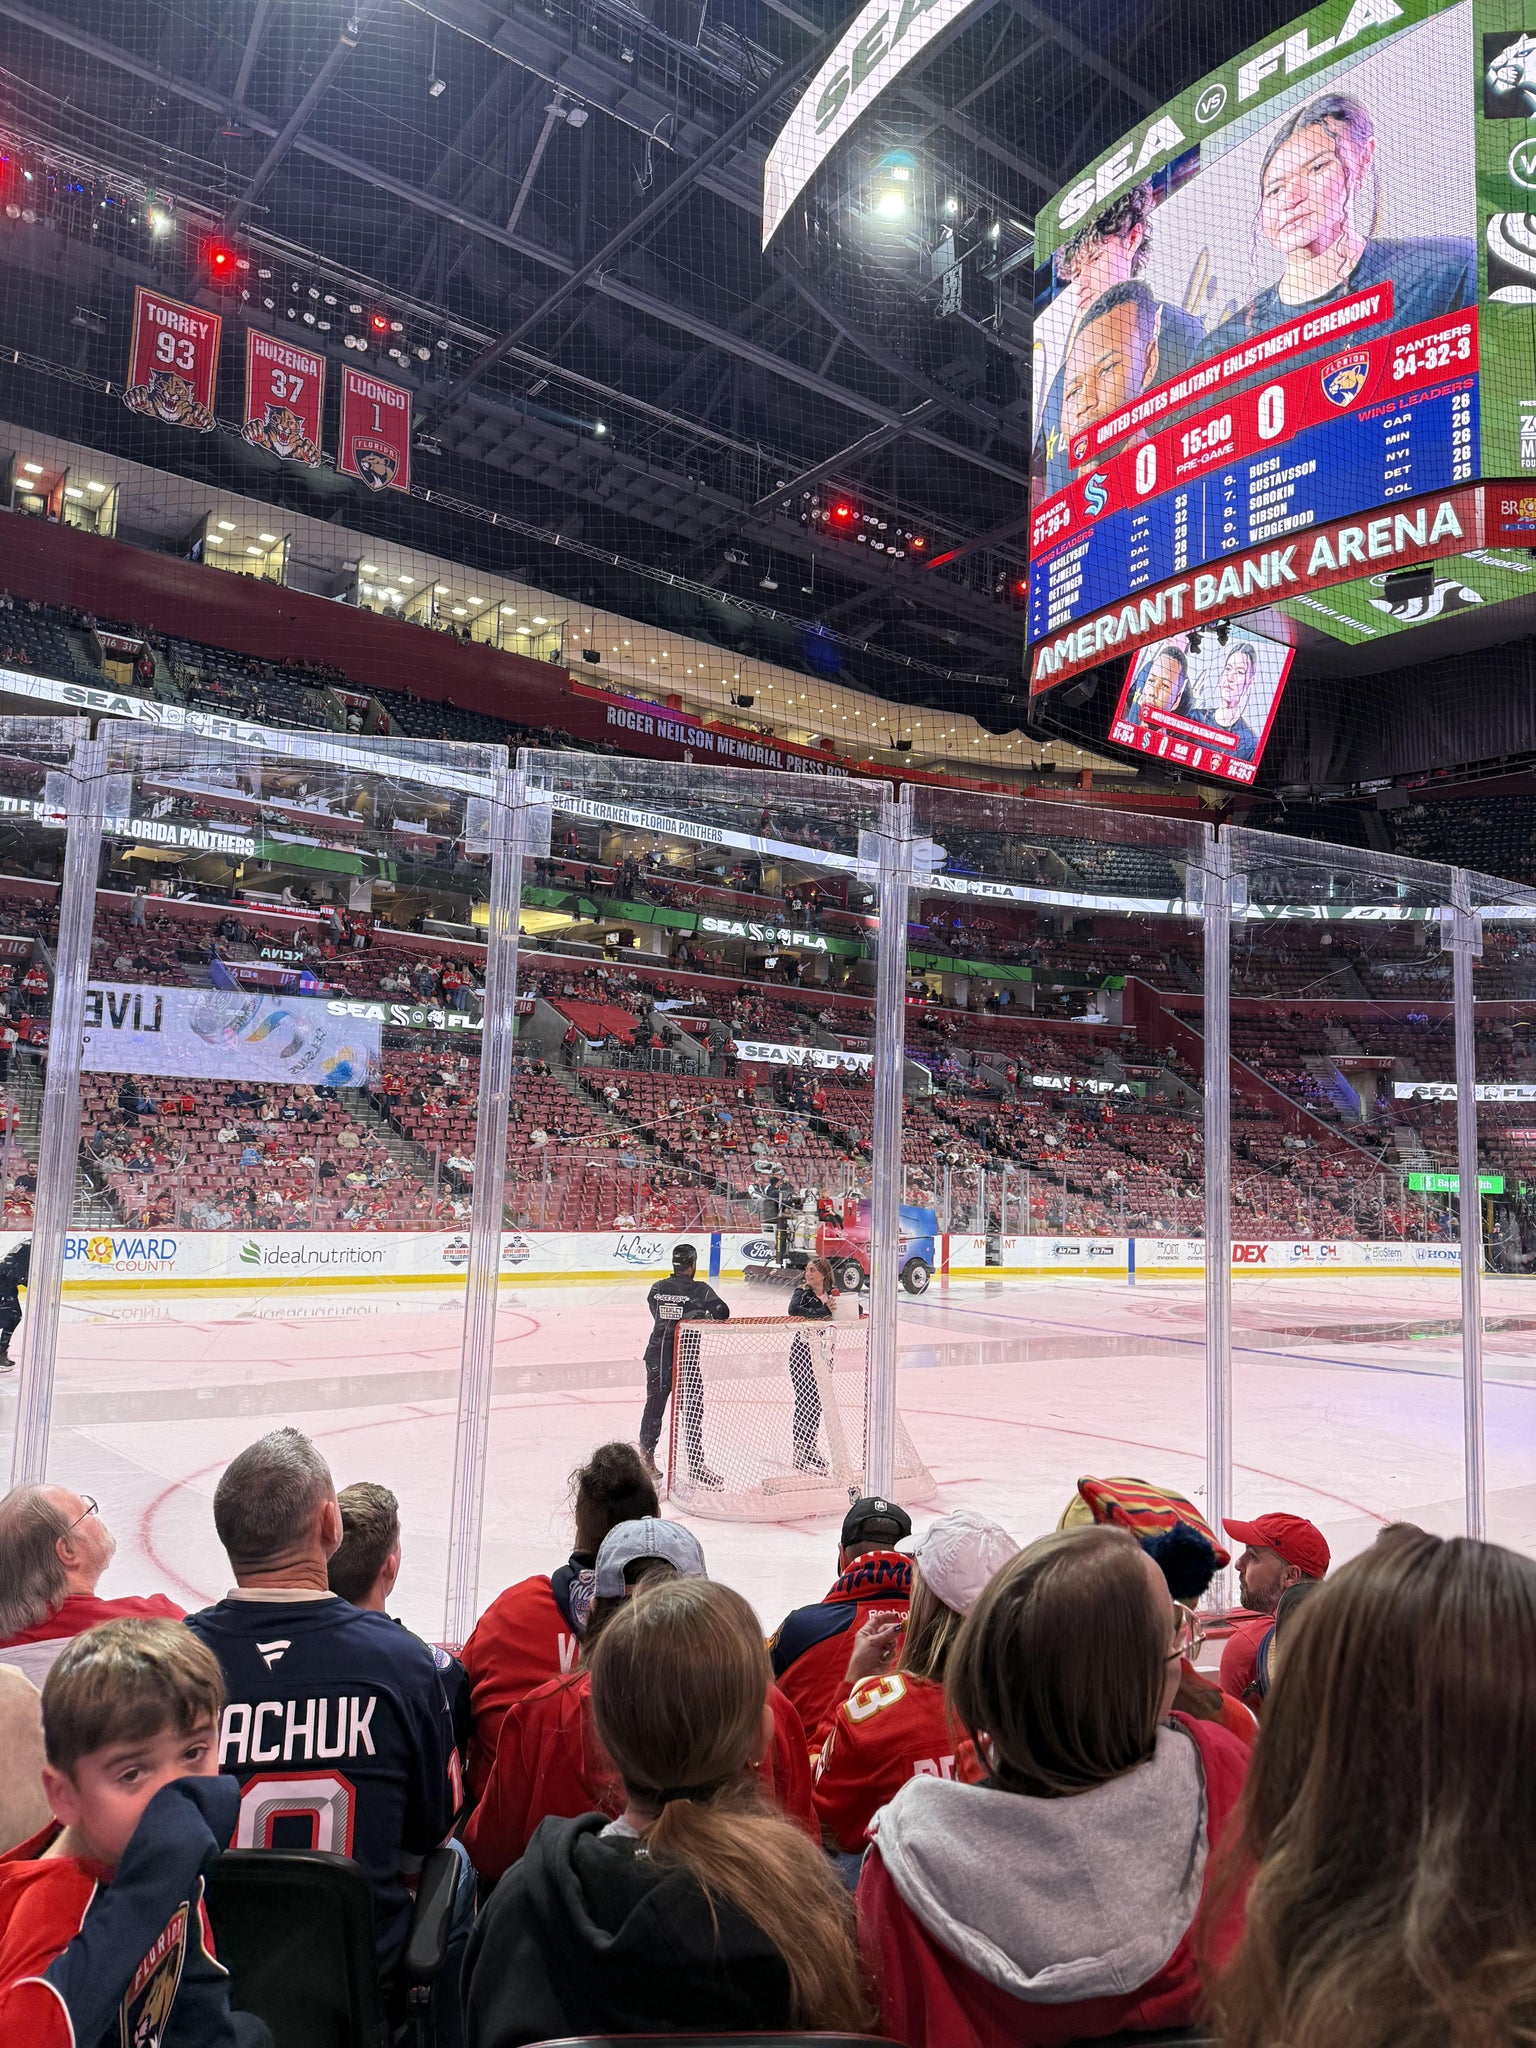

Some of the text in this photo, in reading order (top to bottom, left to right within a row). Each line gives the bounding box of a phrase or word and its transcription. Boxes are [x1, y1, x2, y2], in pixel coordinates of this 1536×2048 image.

[1059, 115, 1186, 230] SEA
[1238, 0, 1403, 102] FLA
[147, 302, 209, 340] TORREY
[156, 331, 195, 370] 93
[1396, 324, 1471, 357] PANTHERS
[255, 339, 318, 377] HUIZENGA
[1097, 294, 1381, 445] UNITED STATES MILITARY ENLISTMENT CEREMONY
[1393, 337, 1470, 380] 34-32-3
[270, 368, 304, 403] 37
[350, 375, 406, 410] LUONGO
[1357, 379, 1474, 422] WINS LEADERS
[371, 403, 383, 433] 1
[1258, 385, 1284, 440] 0
[357, 440, 395, 458] FLORIDA
[1181, 414, 1232, 458] 15:00
[1223, 393, 1470, 487] 6. BUSSI CAR 26
[1135, 444, 1156, 495] 0
[1176, 442, 1234, 475] PRE-GAME
[1223, 410, 1471, 502] 7. GUSTAVSSON MIN 26
[1223, 428, 1471, 517] 8. SOROKIN NYI 26
[1223, 445, 1471, 533] 9. GIBSON DET 26
[1035, 500, 1067, 526] KRAKEN
[1132, 515, 1149, 527] TBL
[1221, 463, 1471, 549] 10. WEDGEWOOD COL 25
[1130, 529, 1150, 542] UTA
[1174, 509, 1188, 525] 32
[1130, 545, 1149, 557] DAL
[1174, 524, 1188, 540] 29
[1036, 528, 1094, 568] WINS LEADERS
[1130, 558, 1149, 572] BOS
[1174, 539, 1188, 555] 28
[1130, 573, 1149, 587] ANA
[1174, 554, 1187, 571] 28
[1035, 500, 1465, 681] AMERANT BANK ARENA
[100, 637, 139, 653] 316 317
[62, 686, 268, 746] SEA FLA
[353, 698, 368, 708] 318
[607, 705, 654, 736] ROGER
[657, 718, 714, 751] NEILSON
[717, 734, 783, 770] MEMORIAL
[786, 755, 823, 776] PRESS
[1158, 736, 1168, 756] 0
[1192, 748, 1203, 767] 0
[552, 794, 591, 815] SEATTLE
[593, 803, 630, 822] KRAKEN
[641, 813, 677, 833] FLORIDA
[679, 822, 723, 842] PANTHERS
[115, 817, 176, 843] FLORIDA
[179, 828, 255, 856] PANTHERS
[912, 872, 941, 888] SEA
[982, 884, 1014, 897] FLA
[8, 942, 27, 954] 116
[702, 917, 828, 949] SEA FLA
[326, 1001, 386, 1021] SEA
[520, 1002, 532, 1012] 118
[695, 1021, 707, 1031] 119
[745, 1045, 783, 1060] SEA
[1032, 1075, 1062, 1089] SEA
[1416, 1086, 1457, 1097] SEA
[65, 1237, 177, 1262] BROWARD
[264, 1247, 383, 1265] idealnutrition
[612, 1235, 662, 1261] LaCroix
[1232, 1244, 1268, 1263] DEX
[115, 1260, 175, 1272] COUNTY
